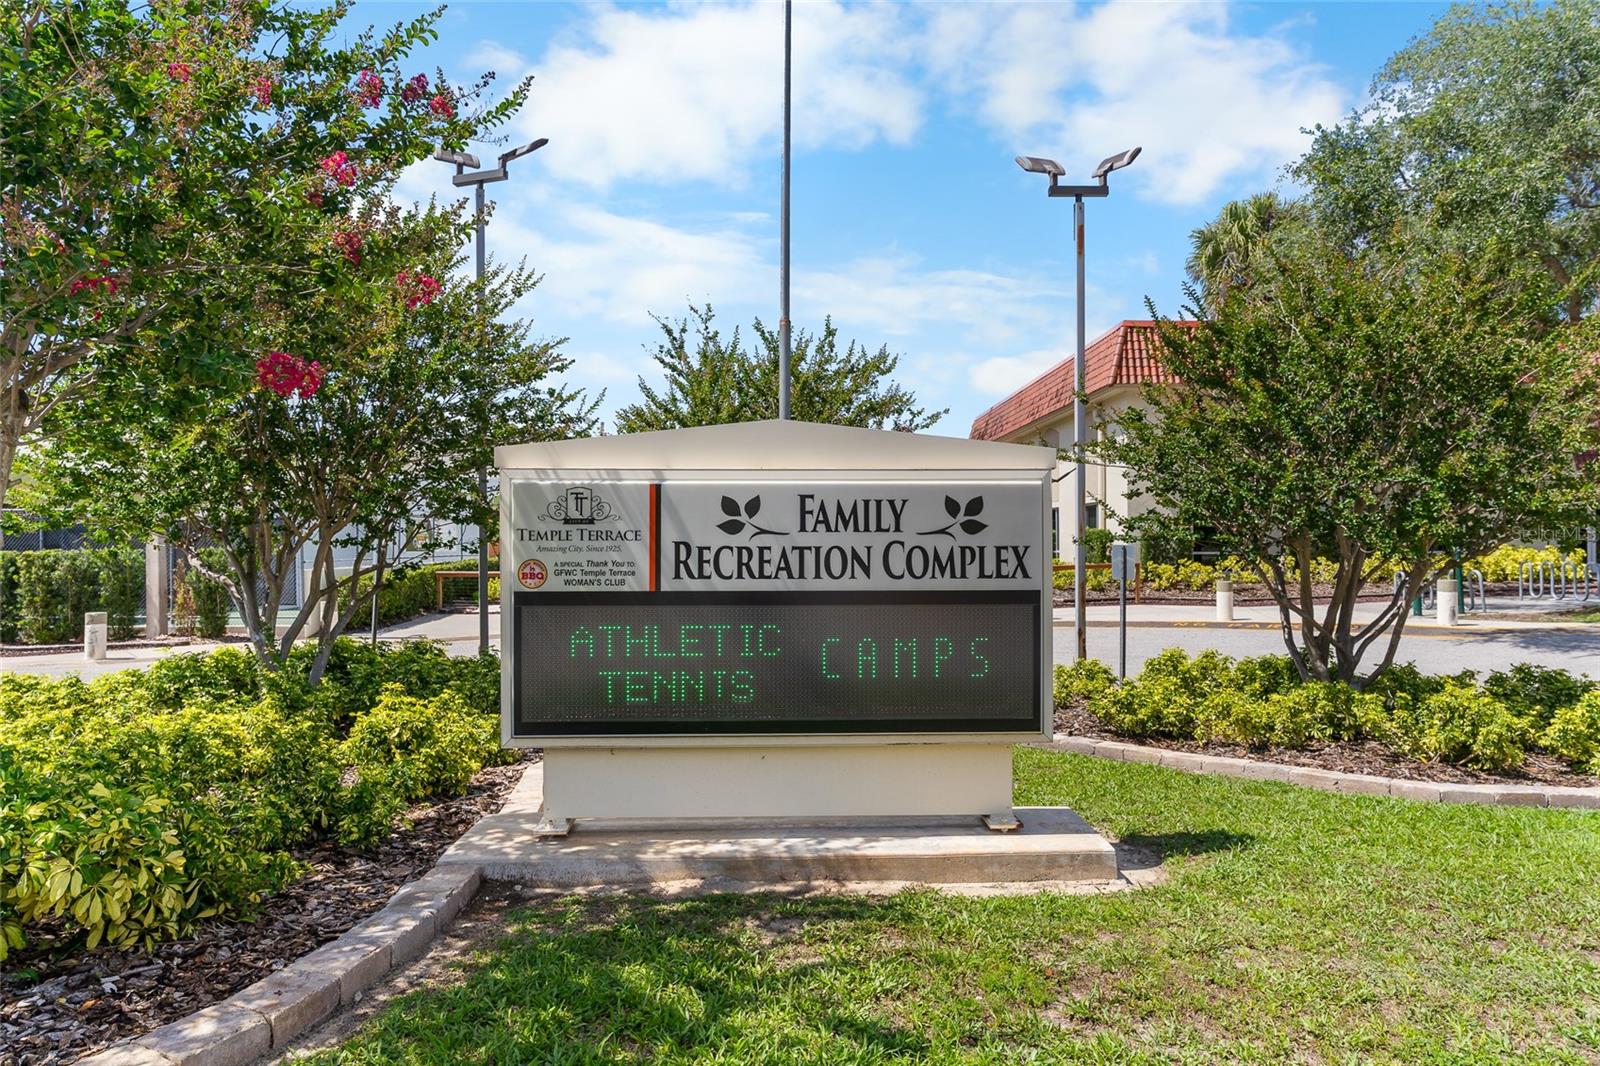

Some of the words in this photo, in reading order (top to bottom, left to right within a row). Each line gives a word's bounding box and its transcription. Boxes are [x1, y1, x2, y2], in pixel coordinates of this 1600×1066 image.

[797, 493, 910, 533] FAMILY
[517, 528, 573, 542] TEMPLE
[576, 528, 642, 542] TERRACE
[536, 545, 567, 554] Amazing
[586, 544, 605, 553] Since
[672, 540, 873, 580] RECREATION
[882, 540, 1032, 580] COMPLEX
[521, 572, 544, 580] BBQ
[564, 578, 602, 586] WOMAN'S
[604, 578, 626, 586] CLUB
[580, 569, 606, 577] Temple
[570, 624, 782, 658] ATHLETIC
[821, 637, 990, 679] CAMPS
[599, 670, 755, 703] TENNIS
